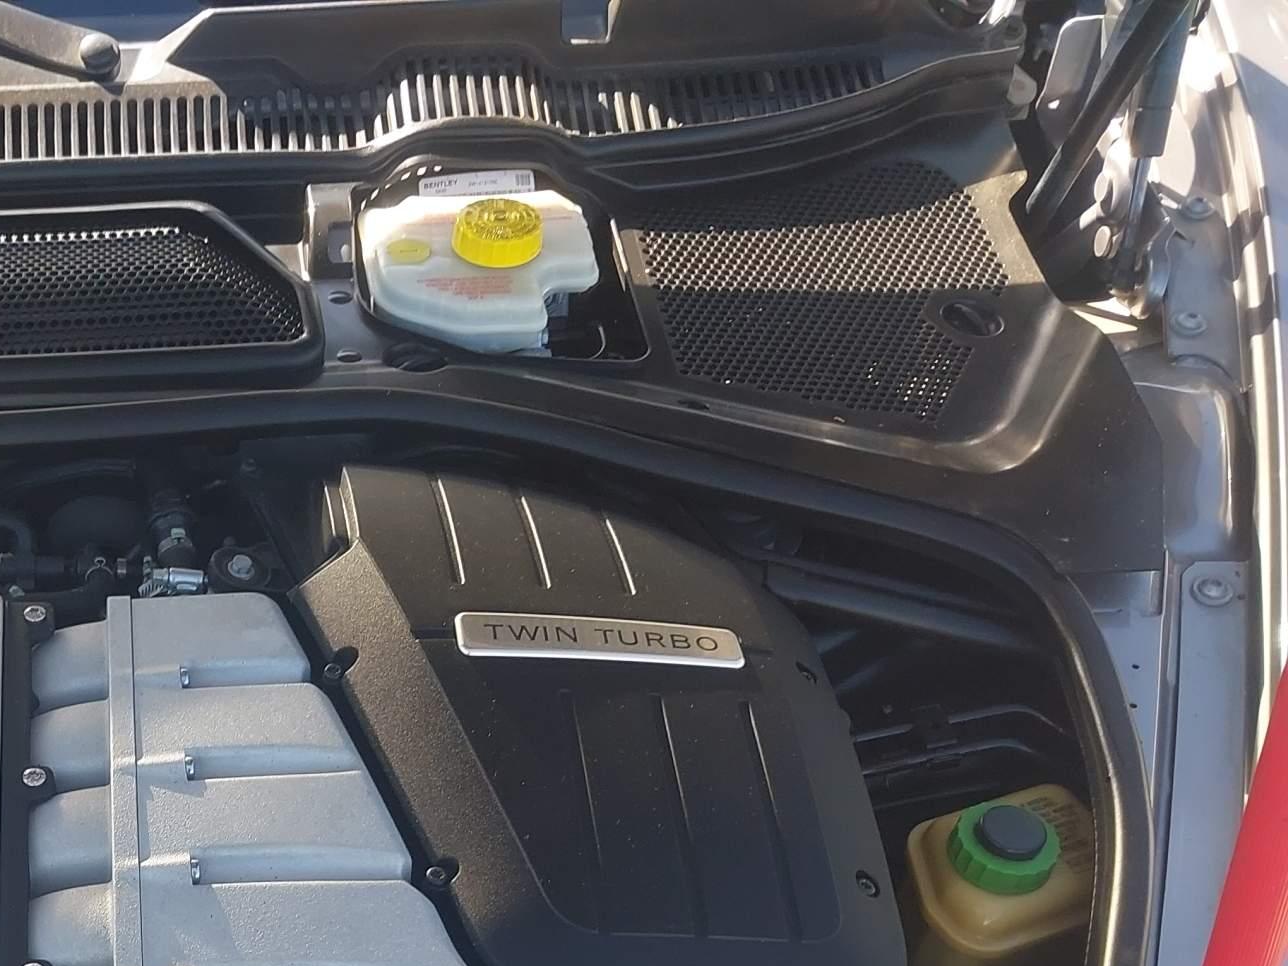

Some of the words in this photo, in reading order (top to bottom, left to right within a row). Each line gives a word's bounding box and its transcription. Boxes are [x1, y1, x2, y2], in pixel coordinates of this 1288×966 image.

[423, 178, 458, 190] BENTLEY
[483, 623, 578, 643] TWIN
[594, 628, 719, 652] TURBO
